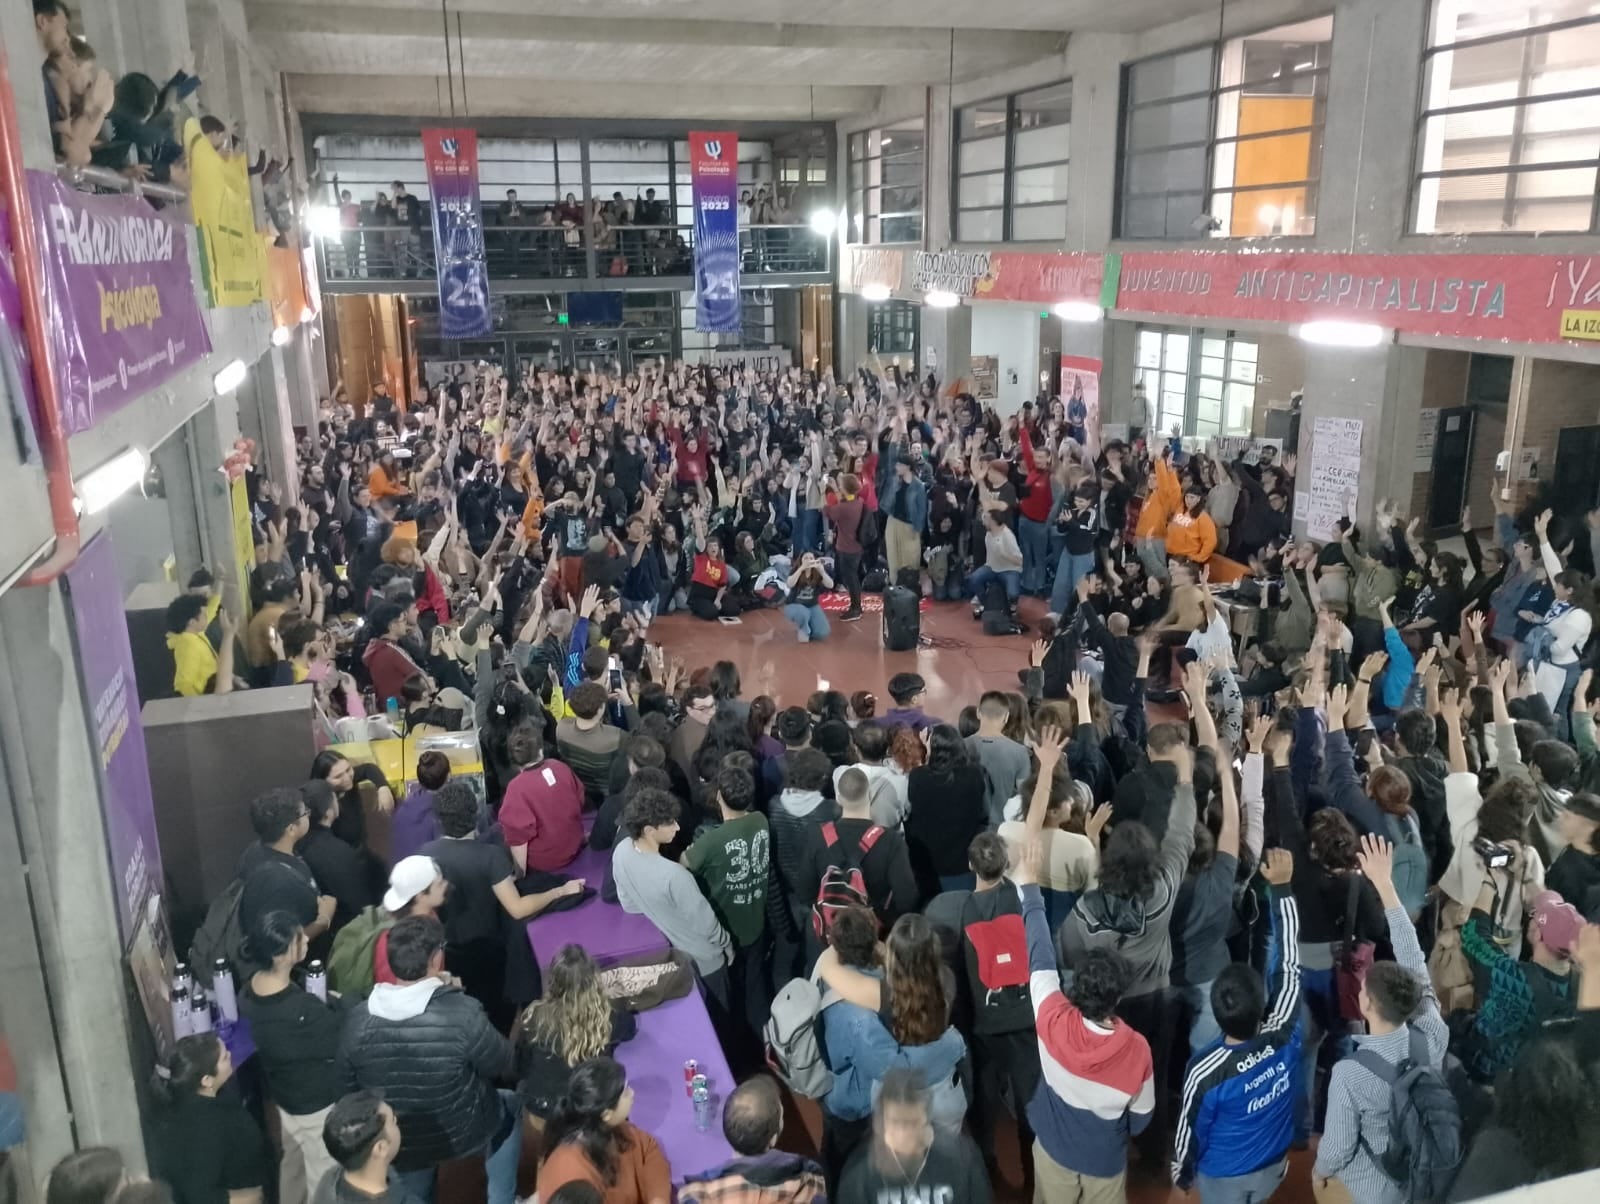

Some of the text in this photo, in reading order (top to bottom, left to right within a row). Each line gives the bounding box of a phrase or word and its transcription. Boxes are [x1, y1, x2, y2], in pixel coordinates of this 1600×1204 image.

[701, 201, 730, 210] 2023
[50, 203, 172, 264] FRANJA MORADA
[1122, 269, 1212, 295] JUVENTUD
[1233, 269, 1506, 318] ANTICAPITALISTA
[1565, 317, 1580, 332] LA
[725, 829, 769, 883] 30
[1236, 1045, 1275, 1072] adidas
